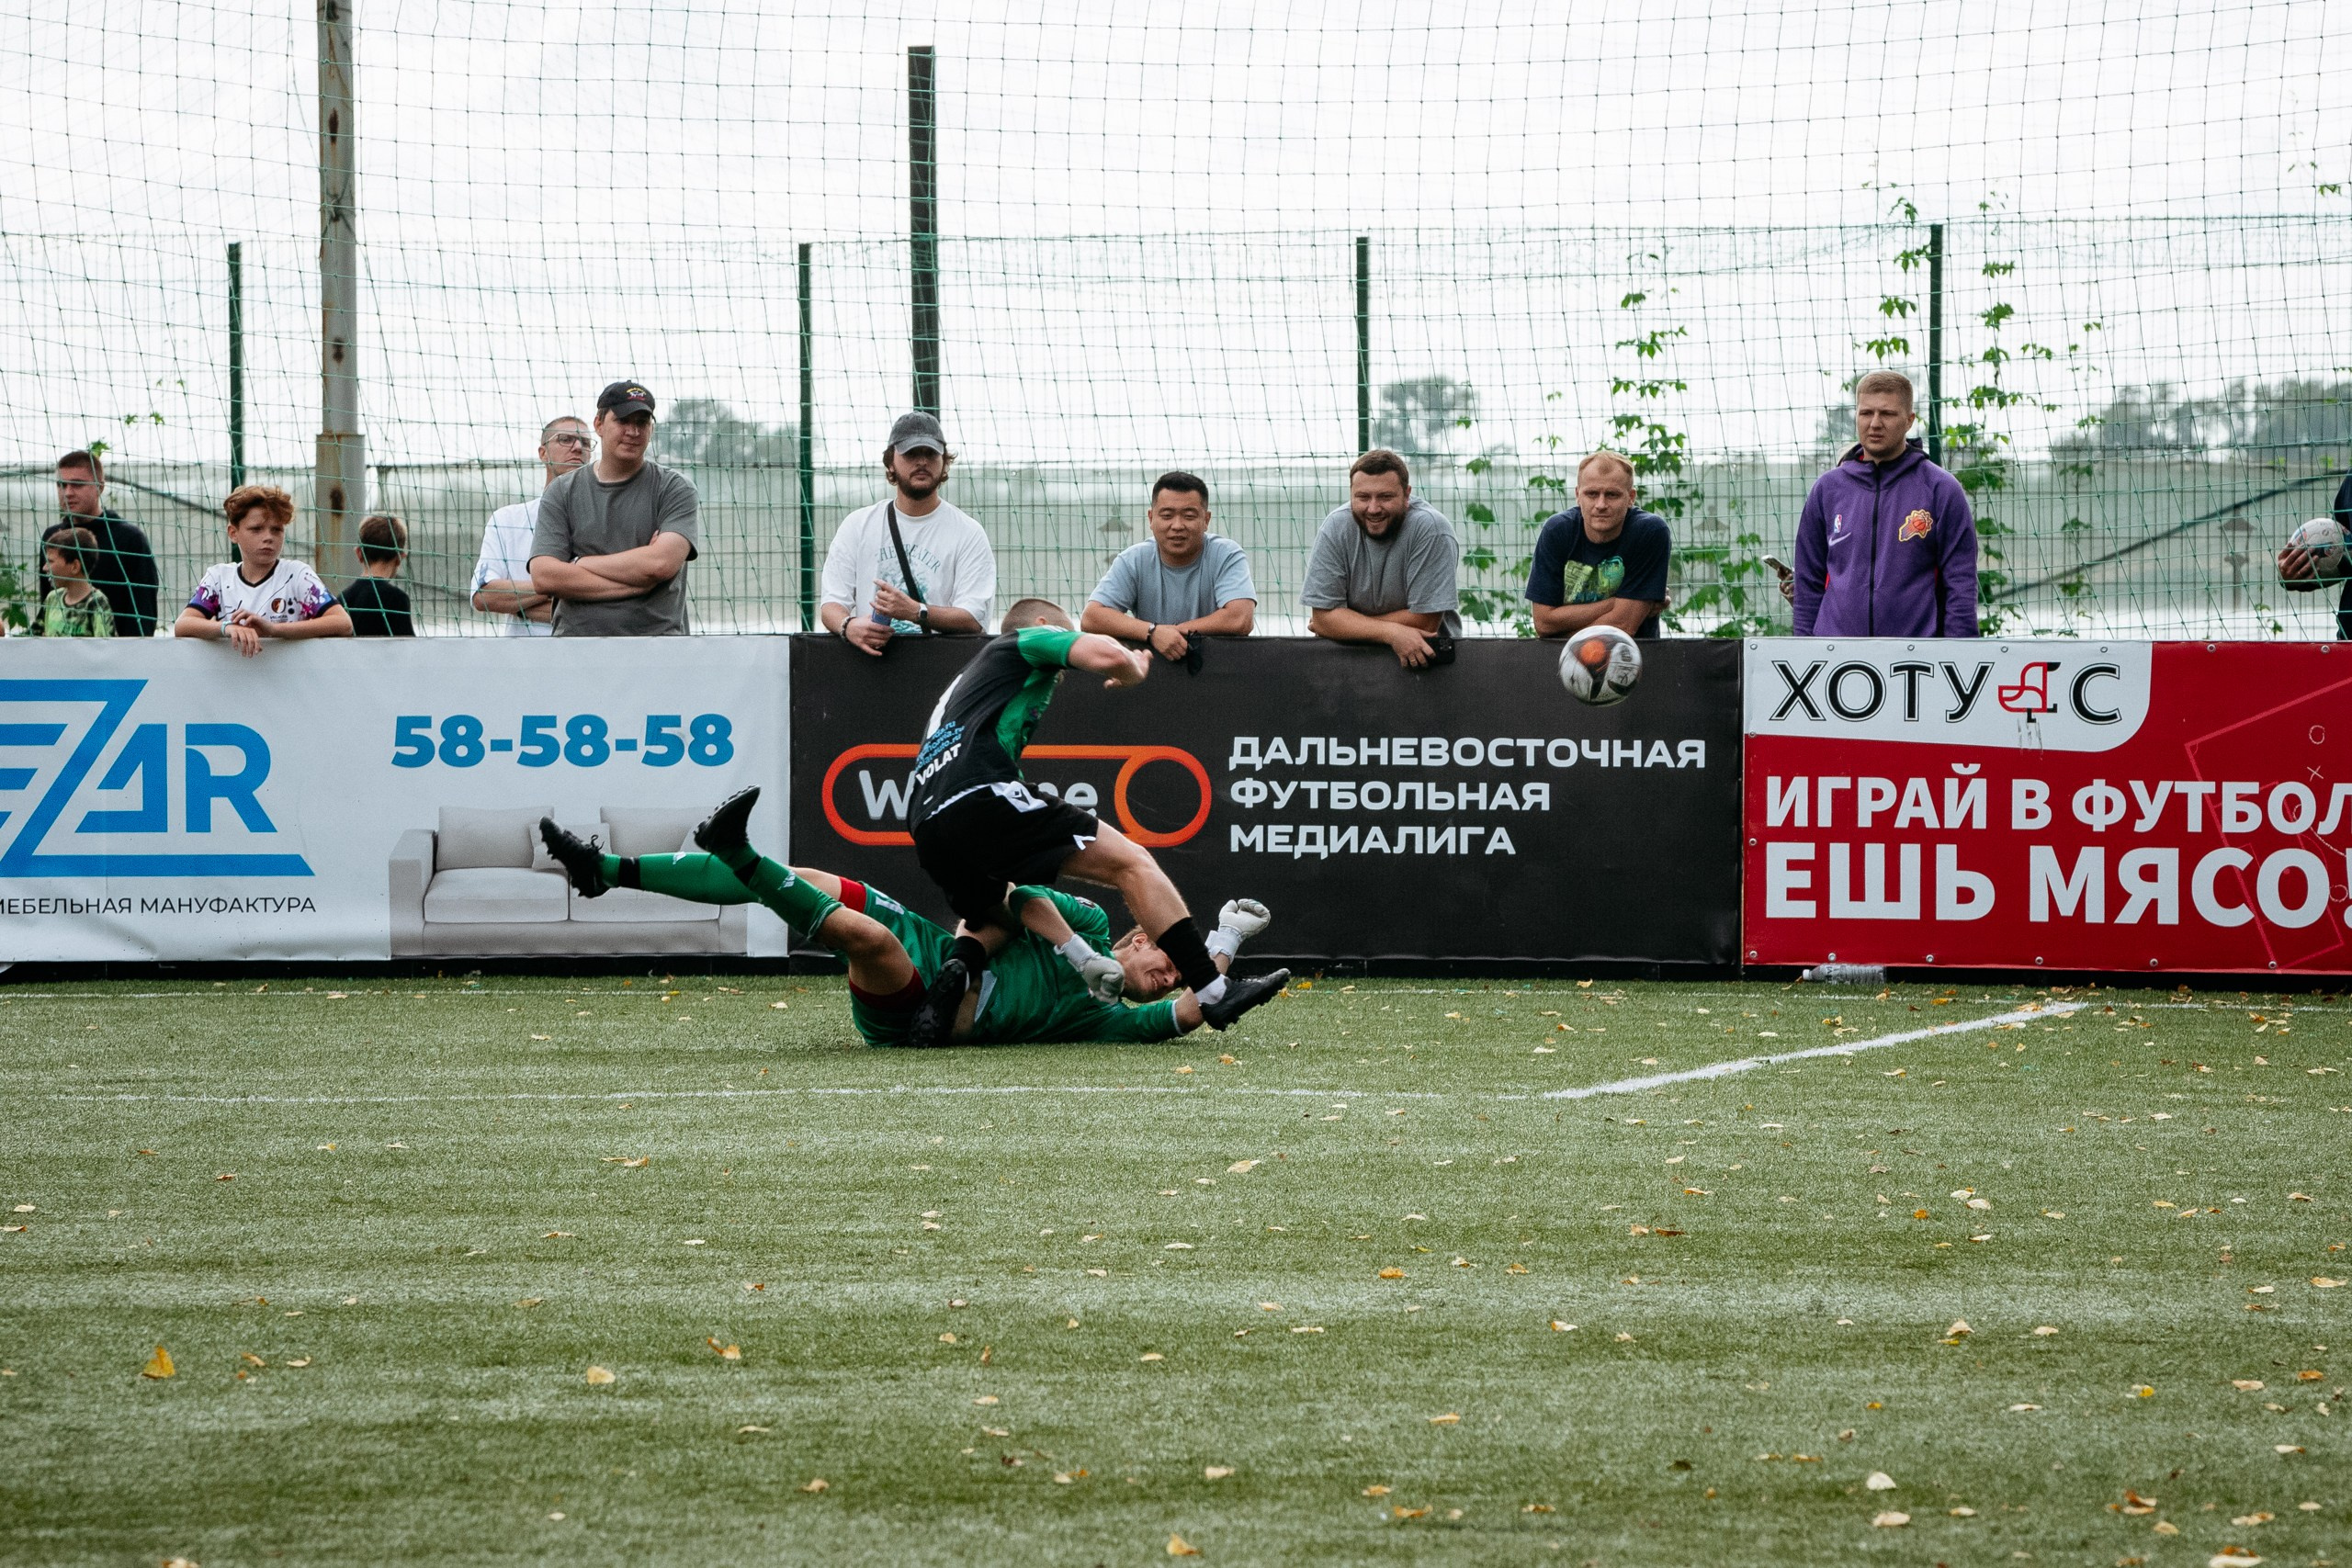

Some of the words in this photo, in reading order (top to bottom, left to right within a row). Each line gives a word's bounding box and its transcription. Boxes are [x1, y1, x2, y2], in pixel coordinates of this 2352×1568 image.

[391, 714, 734, 768] 58-58-58
[1228, 737, 1706, 771] ДАЛЬНЕВОСТОЧНАЯ
[915, 742, 962, 786] VOLAT
[1230, 778, 1550, 811] ФУТБОЛЬНАЯ
[1766, 763, 1987, 829] ИГРАЙ
[2011, 779, 2052, 830] В
[1230, 825, 1517, 860] МЕДИАЛИГА
[1765, 842, 1996, 921] ЕШЬ
[0, 897, 131, 915] ЕБЕЛЬНАЯ
[141, 897, 316, 914] МАНУФАКТУРА
